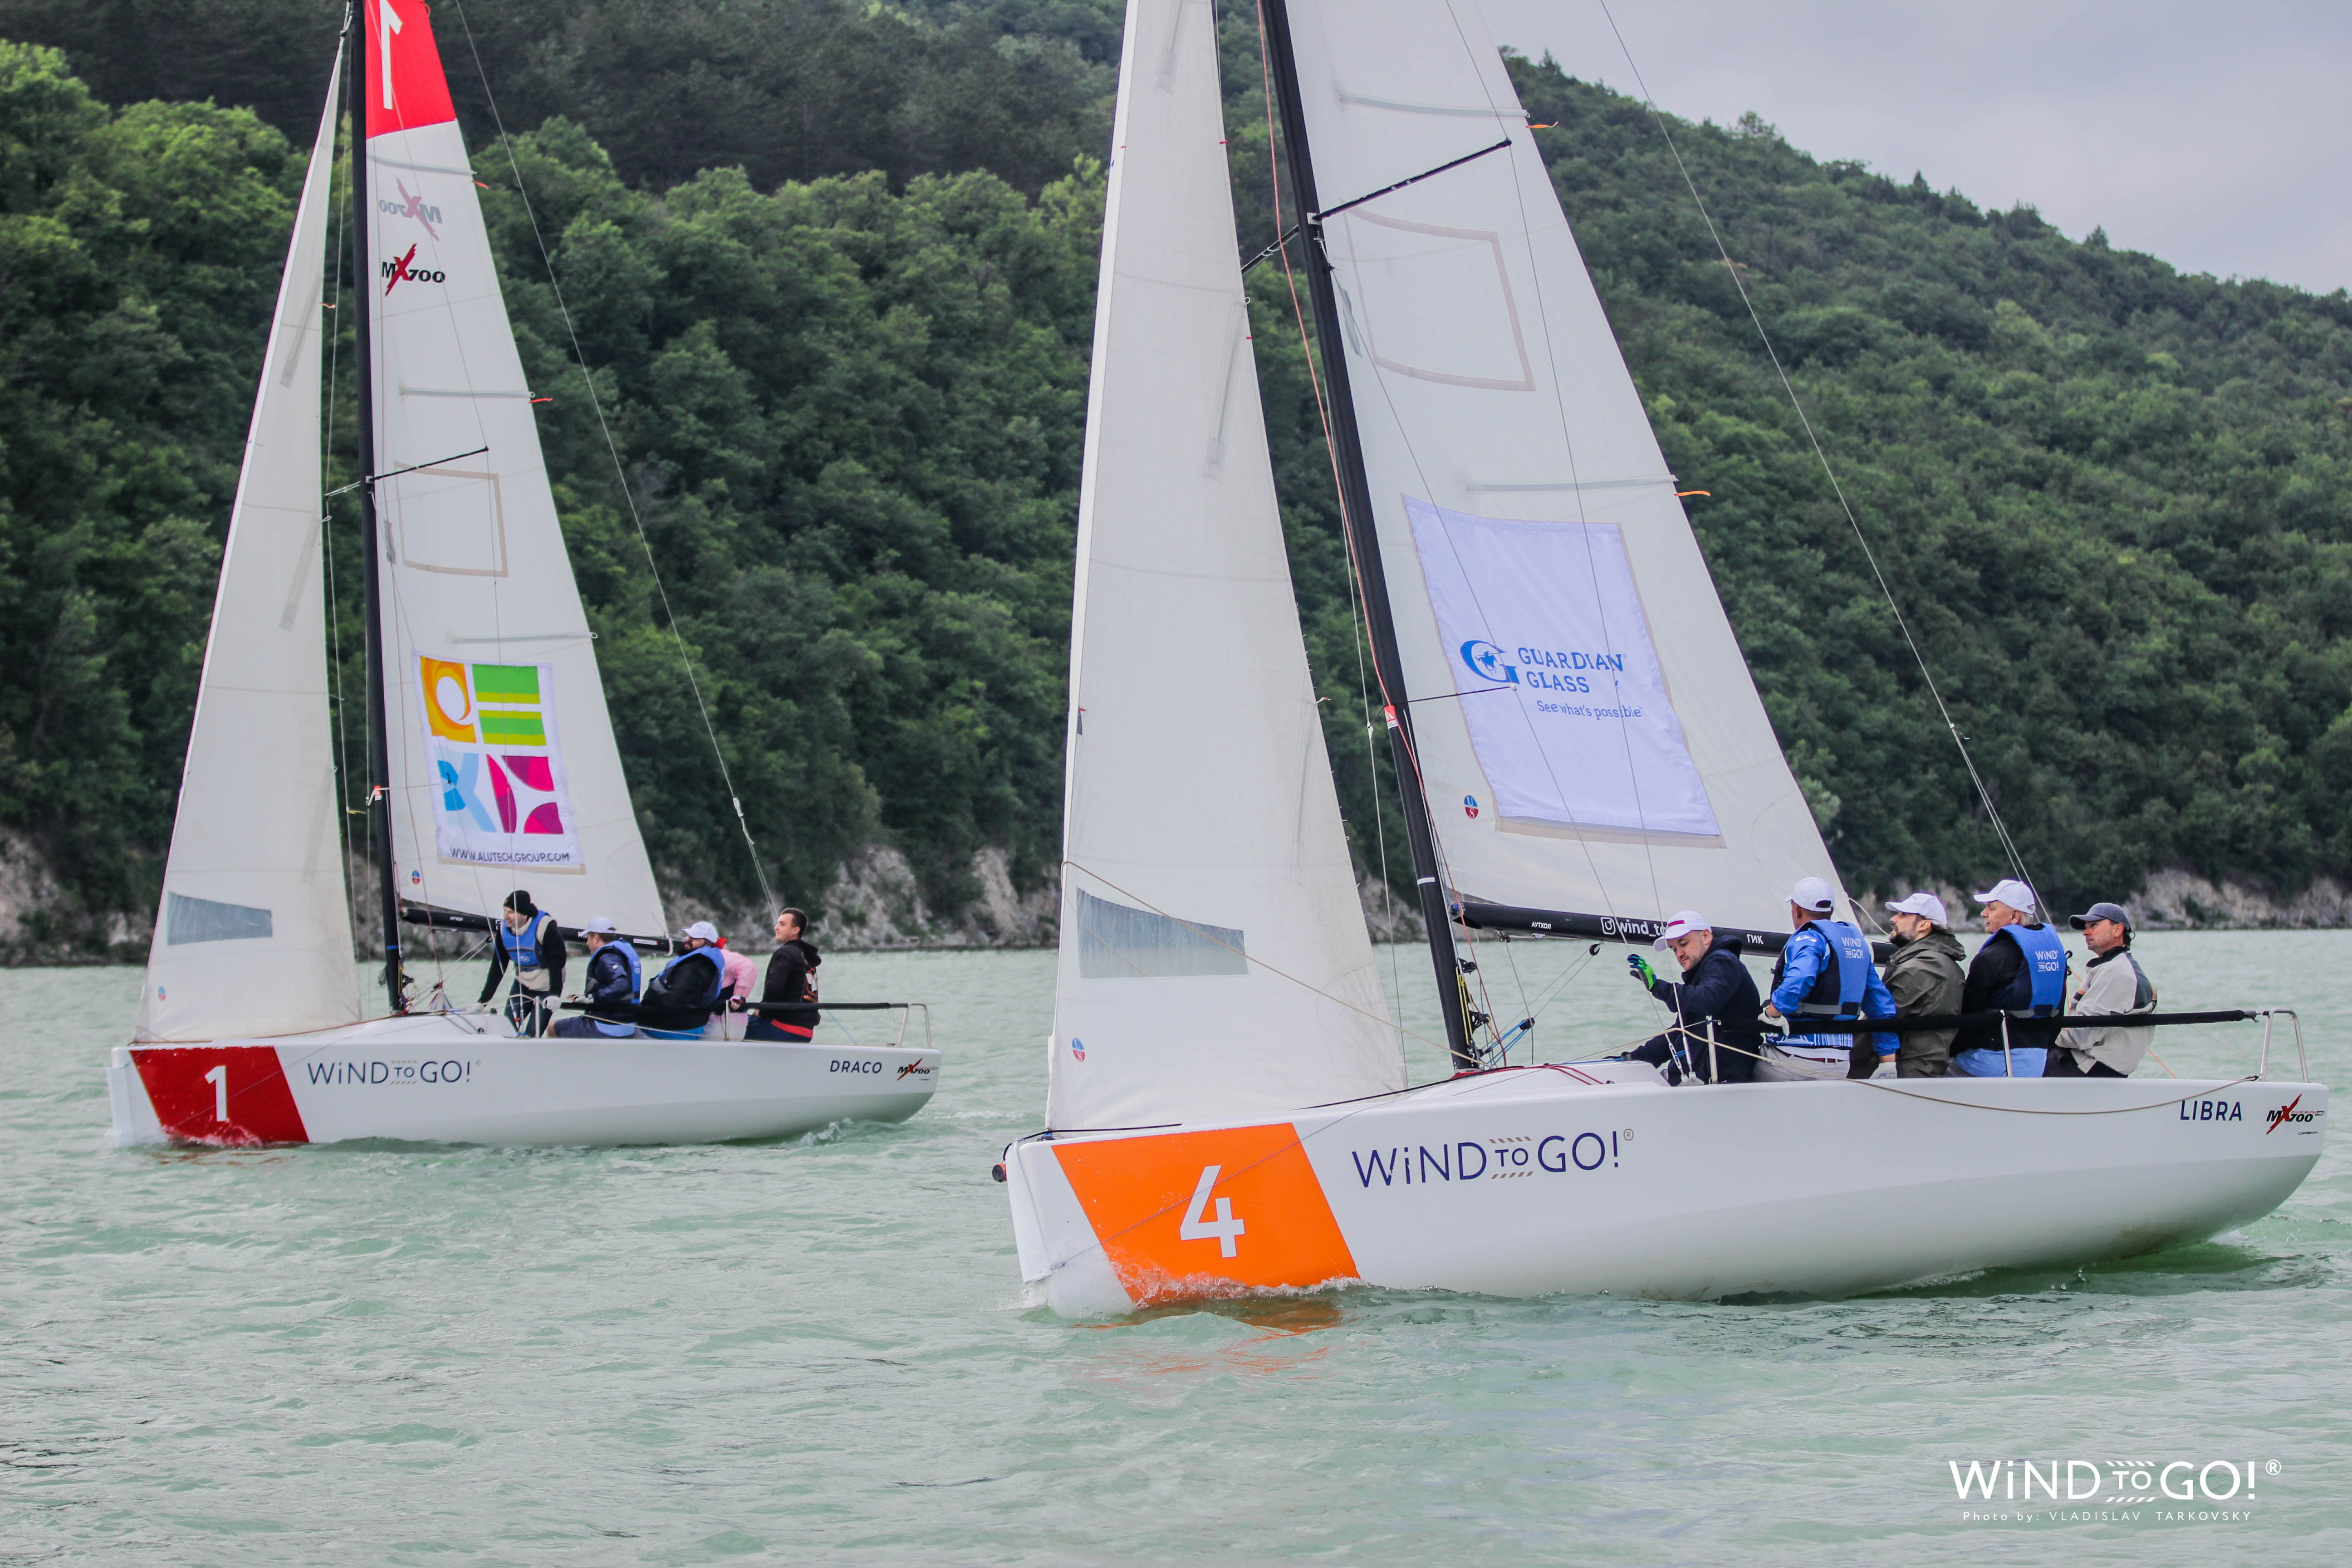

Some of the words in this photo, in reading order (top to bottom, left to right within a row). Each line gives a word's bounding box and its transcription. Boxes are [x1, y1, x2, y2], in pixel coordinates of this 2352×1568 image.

[381, 243, 445, 297] MX700
[1526, 671, 1590, 693] GLASS
[1537, 700, 1558, 712] See
[1561, 703, 1592, 717] what's
[450, 847, 569, 862] WWW.ALUTECH.GROUP.COM
[1747, 934, 1764, 945] ГИК
[1852, 949, 1864, 959] GO!
[2045, 961, 2059, 971] GO!
[394, 1067, 415, 1078] TO
[829, 1060, 882, 1074] DRACO
[897, 1057, 930, 1081] MX700
[204, 1065, 227, 1122] 1
[2180, 1100, 2242, 1122] LIBRA
[2266, 1093, 2313, 1135] MX700
[1495, 1147, 1529, 1167] TO
[1180, 1165, 1245, 1258] 4
